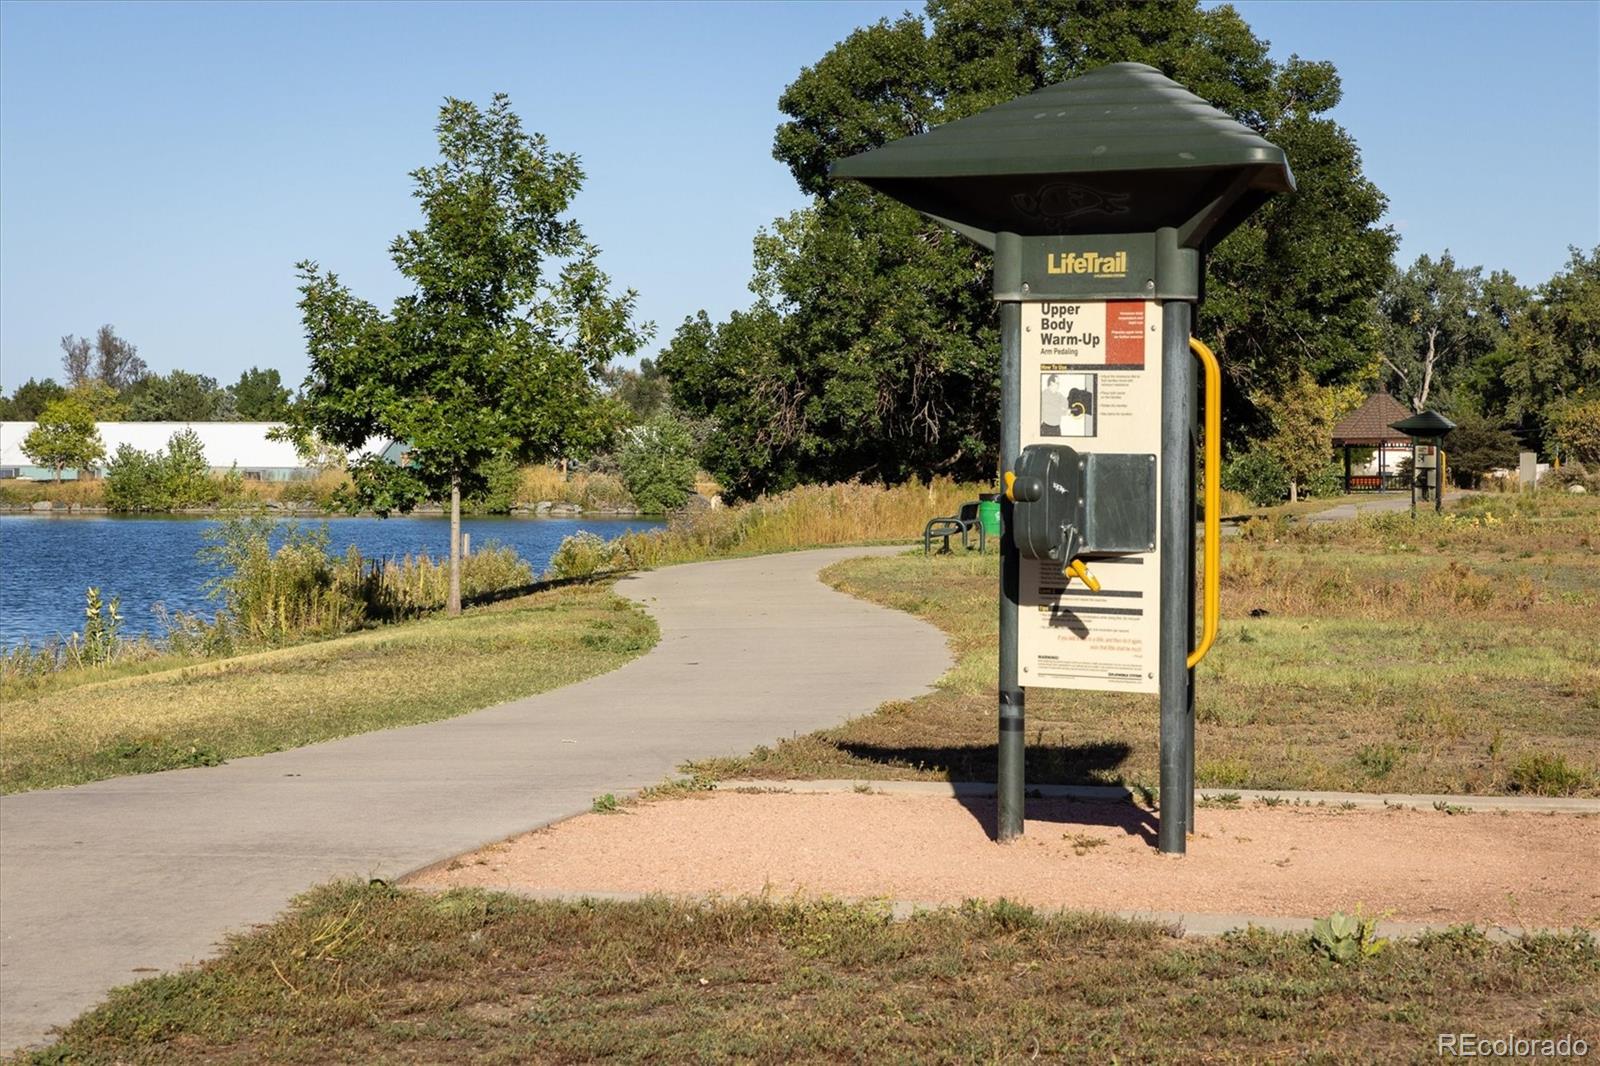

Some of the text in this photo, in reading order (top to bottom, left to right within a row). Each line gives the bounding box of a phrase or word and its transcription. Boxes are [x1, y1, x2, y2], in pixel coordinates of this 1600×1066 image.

[1047, 252, 1127, 274] LifeTrail
[1041, 303, 1080, 317] Upper
[1041, 318, 1074, 333] Body
[1041, 333, 1100, 347] Warm-Up
[1054, 348, 1078, 356] Pedaling
